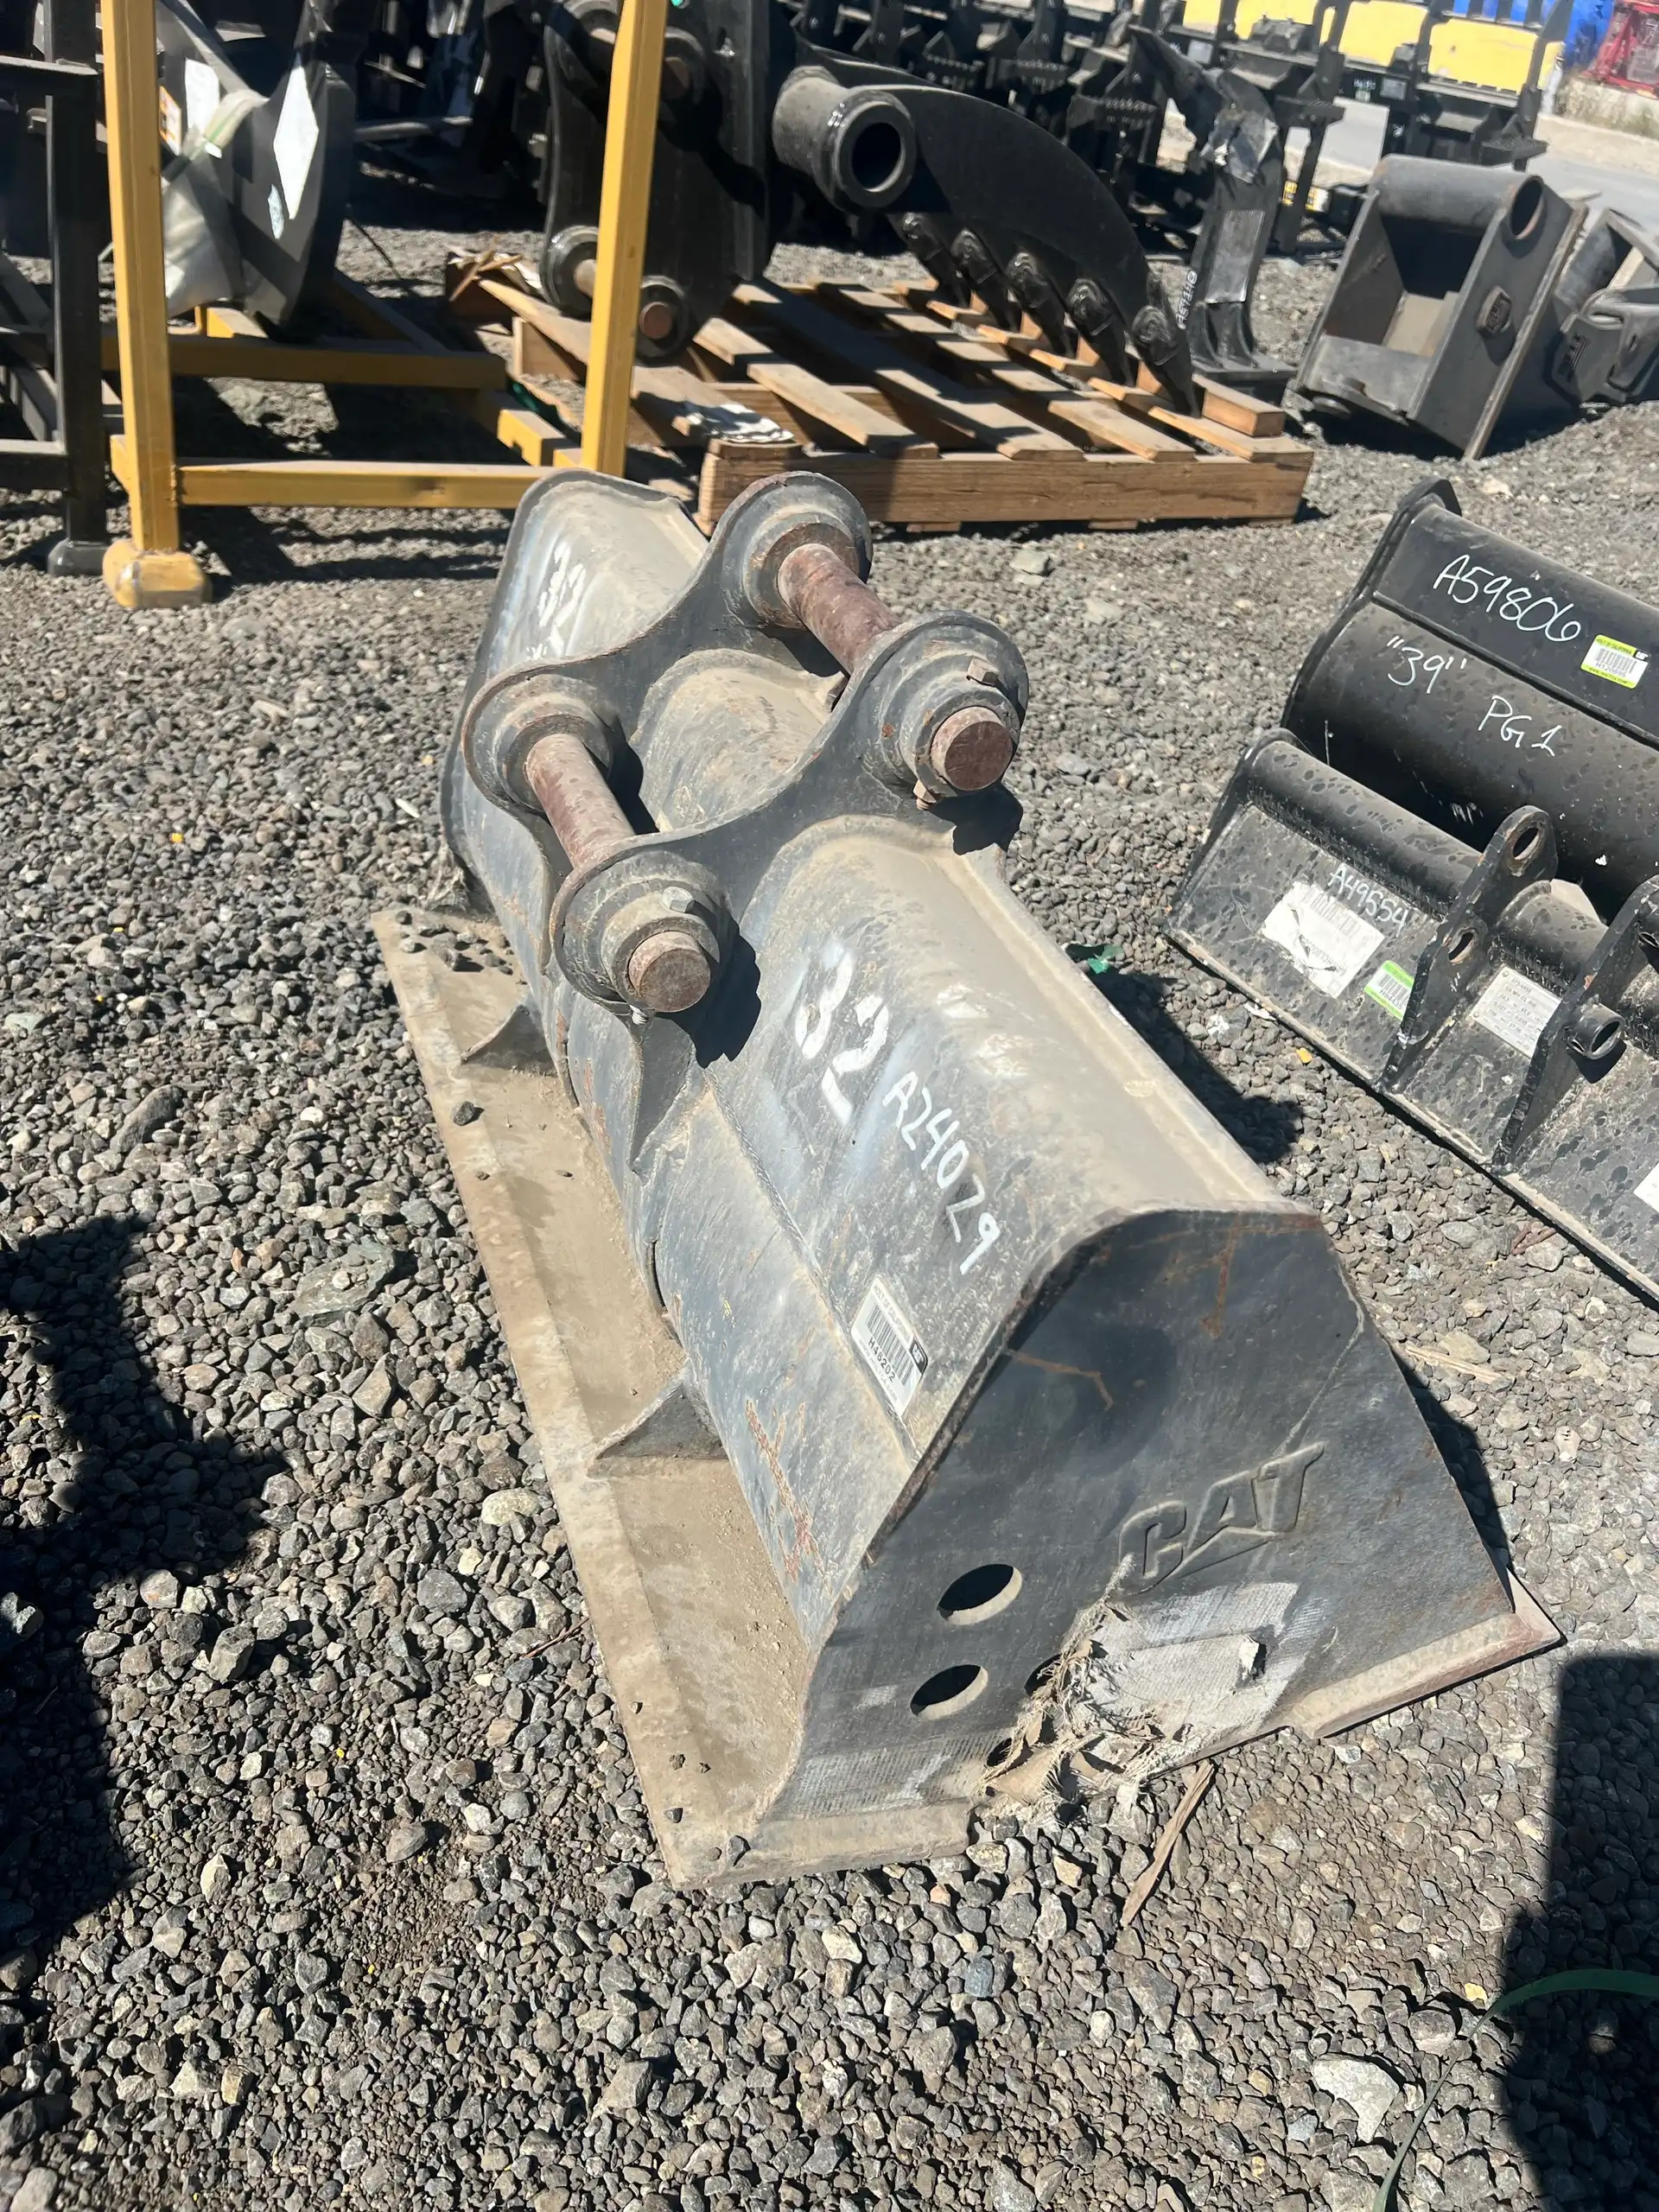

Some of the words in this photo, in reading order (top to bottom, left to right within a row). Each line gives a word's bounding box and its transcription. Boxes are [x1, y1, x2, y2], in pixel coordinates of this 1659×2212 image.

[1433, 554, 1581, 641] A59806
[1327, 862, 1409, 938] A49554
[882, 1071, 1001, 1275] A24029
[868, 1338, 896, 1382] H46202
[1117, 1440, 1325, 1595] CAT
